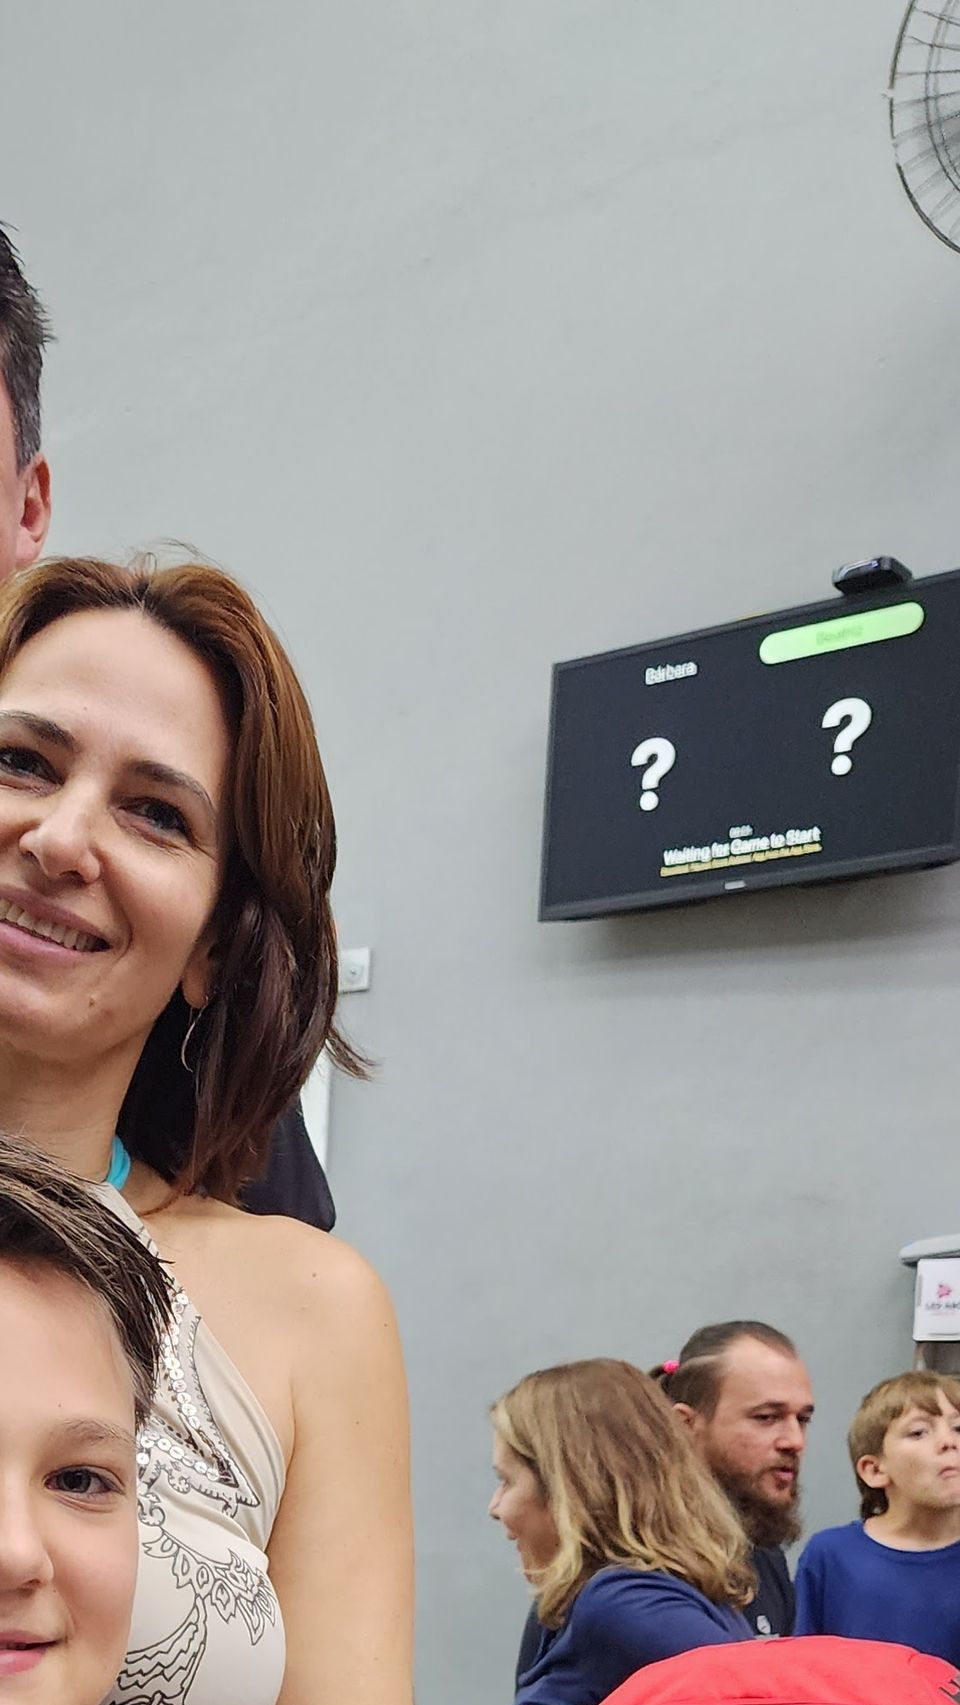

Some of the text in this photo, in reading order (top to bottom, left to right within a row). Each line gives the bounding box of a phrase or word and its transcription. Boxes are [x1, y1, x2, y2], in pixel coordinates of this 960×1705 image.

[631, 697, 872, 812] ? ?
[663, 845, 711, 866] Waiting
[711, 841, 730, 858] for
[730, 836, 770, 855] Game
[770, 832, 786, 848] to
[786, 826, 822, 846] Start
